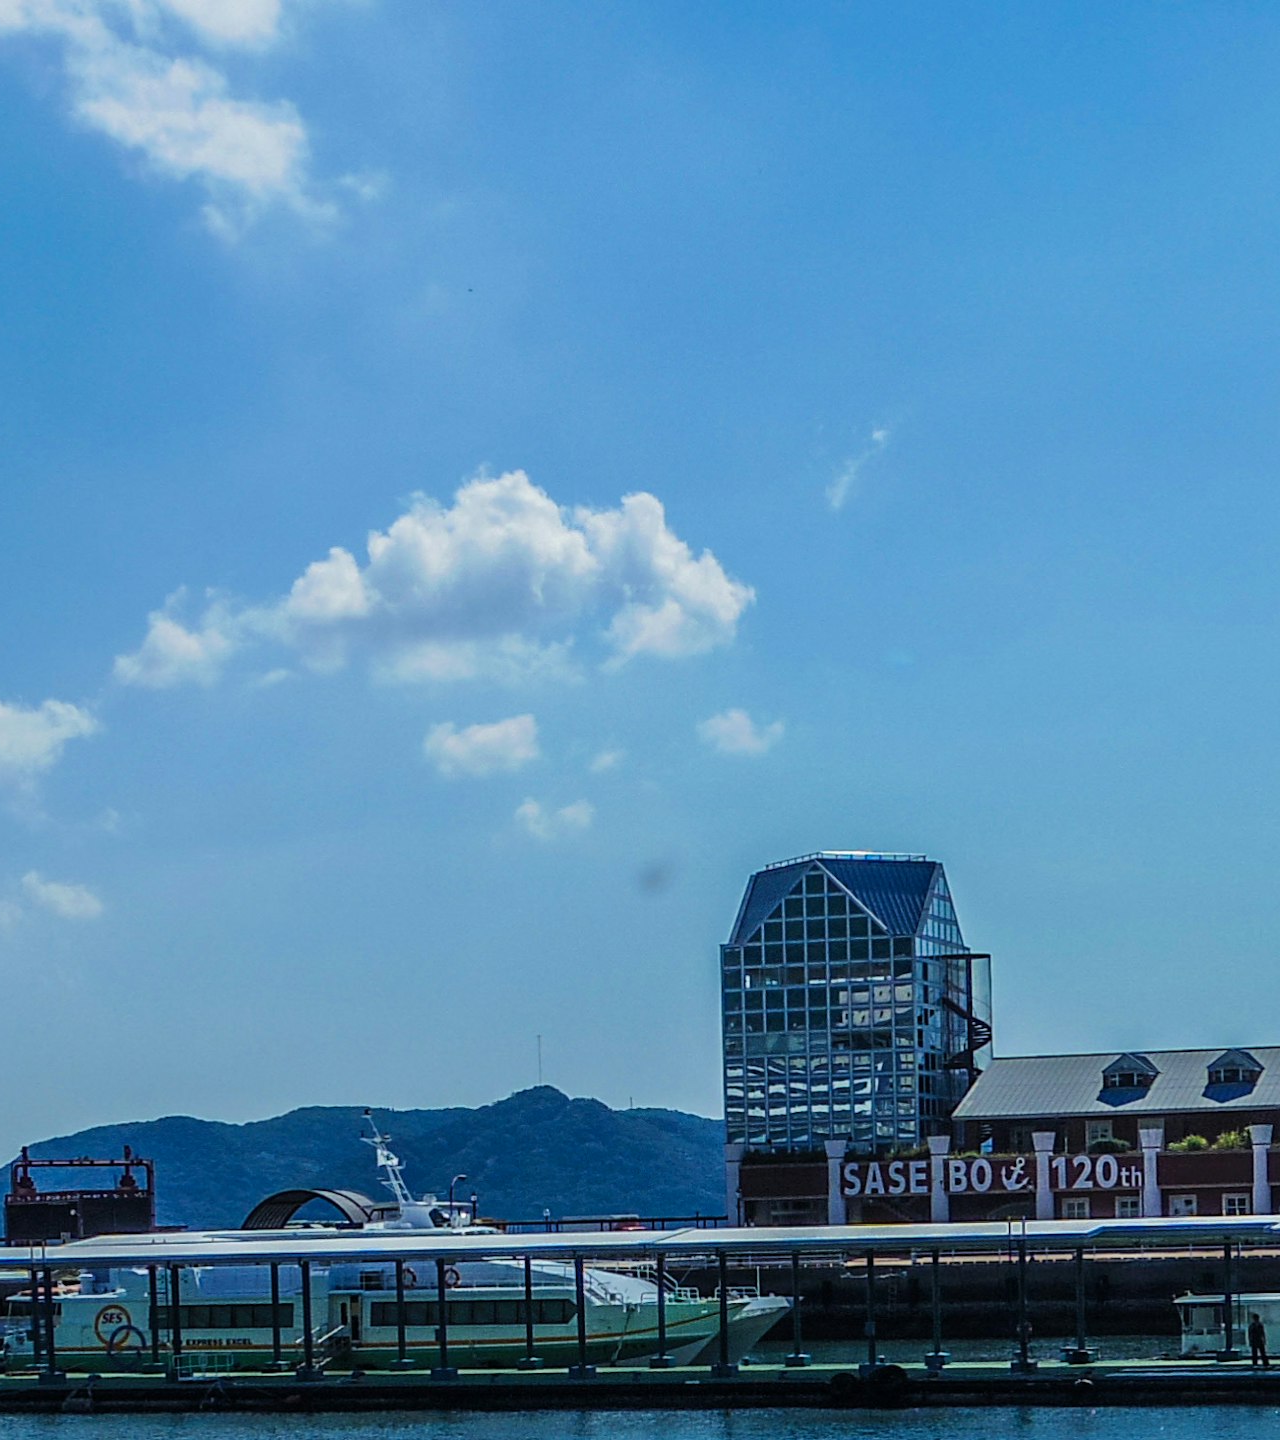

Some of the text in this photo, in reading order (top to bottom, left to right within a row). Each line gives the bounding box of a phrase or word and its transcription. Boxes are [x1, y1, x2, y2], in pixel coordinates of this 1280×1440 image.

[843, 1154, 1143, 1196] SASEBO 120th
[101, 1312, 123, 1324] SES
